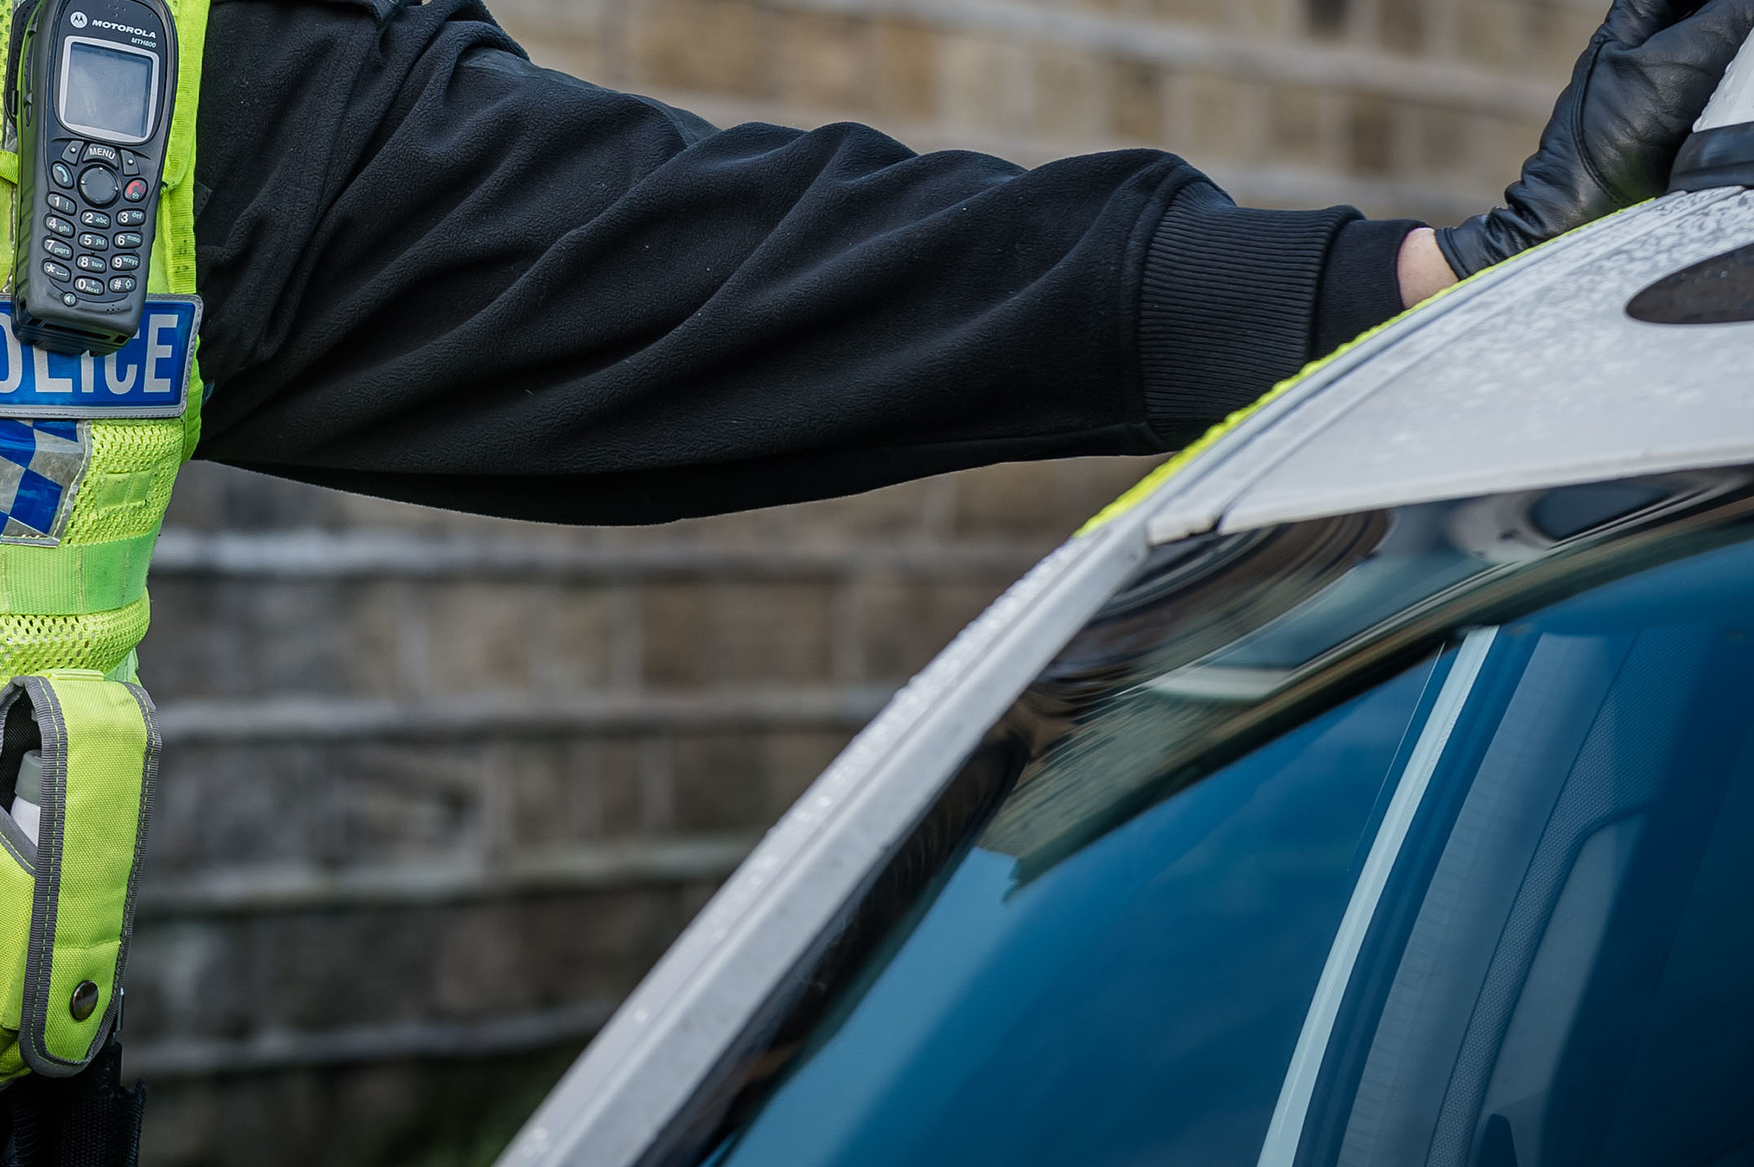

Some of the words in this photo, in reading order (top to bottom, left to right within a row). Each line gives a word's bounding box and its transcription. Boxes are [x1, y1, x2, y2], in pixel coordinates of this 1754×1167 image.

[92, 19, 156, 39] MOTOROLA
[89, 147, 116, 160] MENU
[54, 196, 60, 207] 1
[85, 213, 93, 223] 2
[95, 216, 108, 224] abc
[120, 213, 129, 222] 3
[49, 218, 57, 229] 4
[58, 225, 70, 233] ghi
[46, 240, 55, 250] 7
[84, 236, 92, 245] 5
[118, 236, 126, 245] 6
[80, 258, 89, 267] 8
[114, 257, 123, 268] 9
[78, 279, 86, 289] 0
